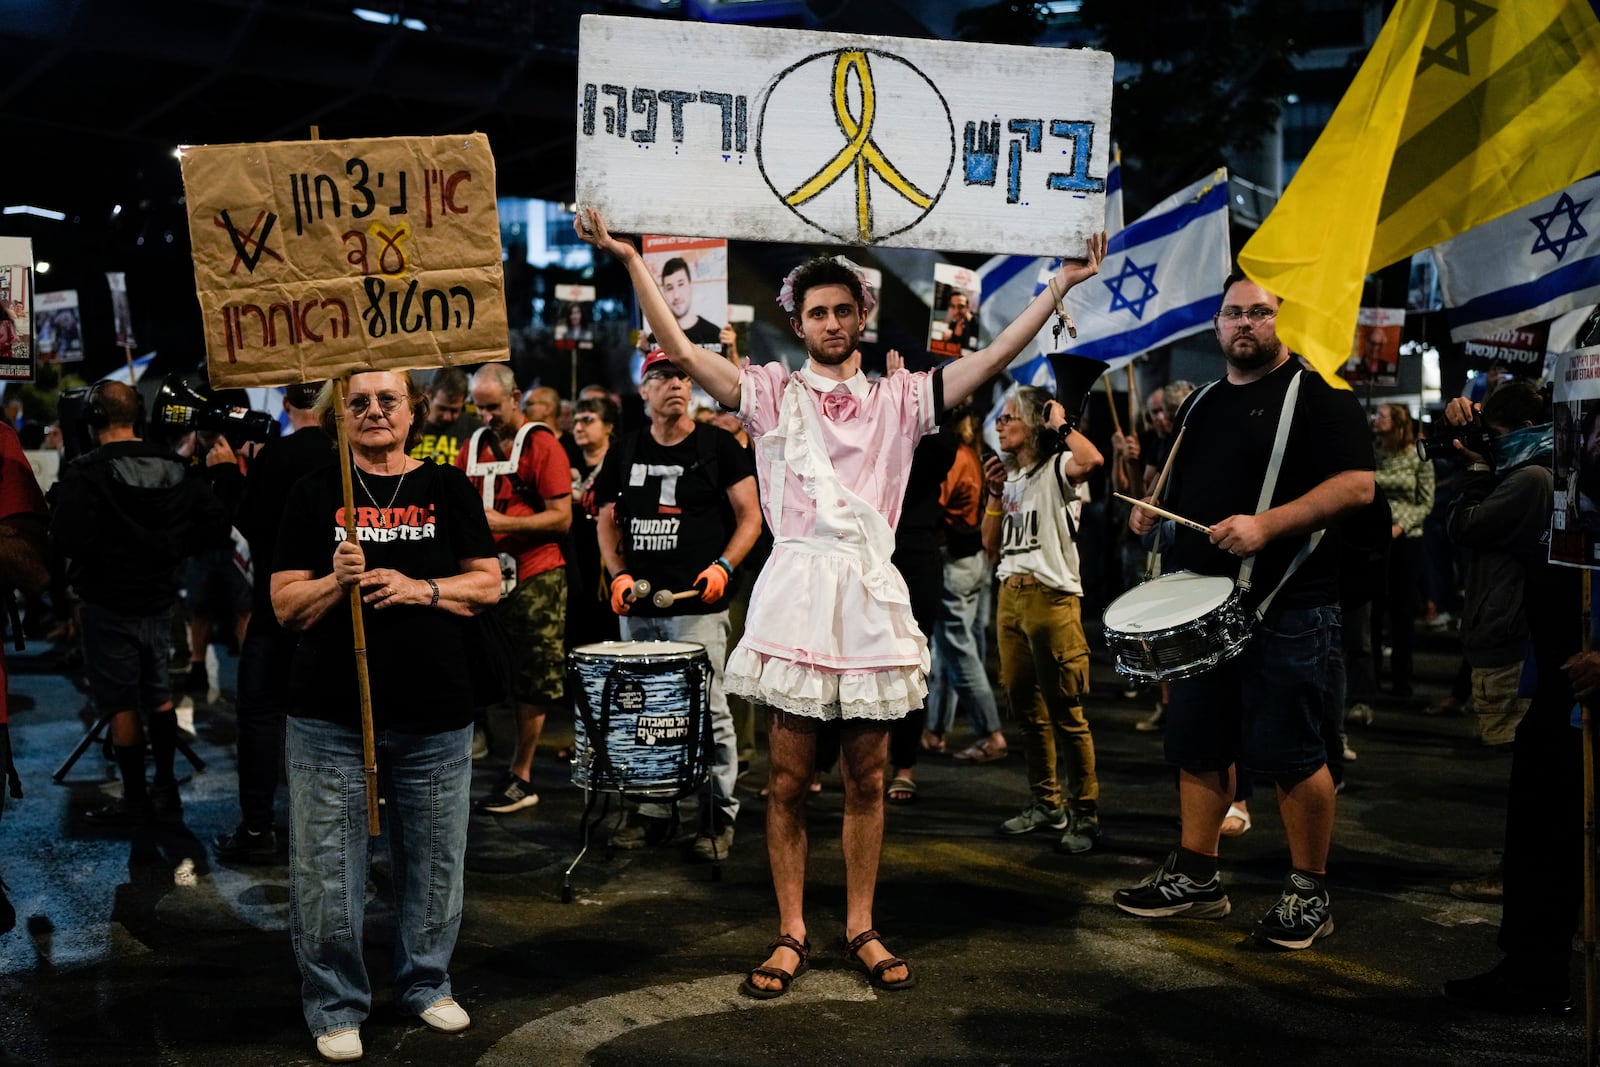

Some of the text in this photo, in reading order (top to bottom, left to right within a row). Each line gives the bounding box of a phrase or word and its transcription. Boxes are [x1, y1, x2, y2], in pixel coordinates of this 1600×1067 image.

[290, 158, 472, 236] אין ניצחון
[222, 277, 475, 364] החטוף האחרון
[629, 463, 684, 507] די
[334, 523, 435, 542] MINISTER
